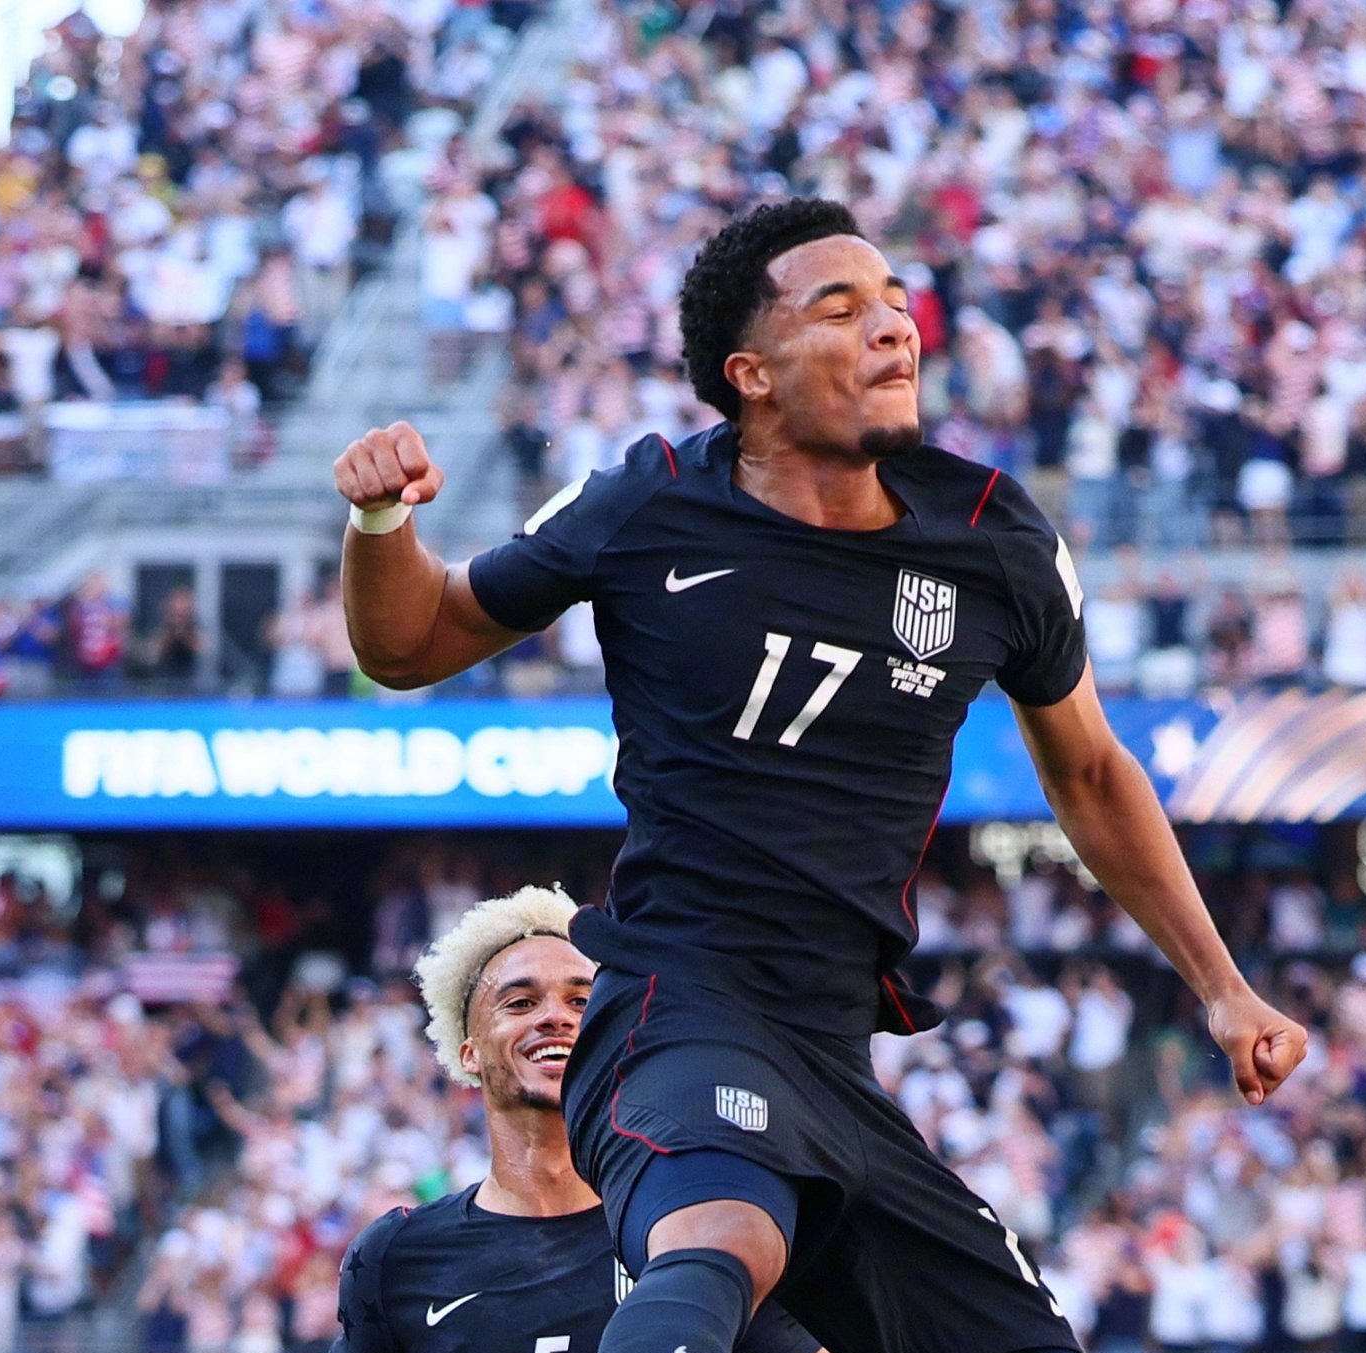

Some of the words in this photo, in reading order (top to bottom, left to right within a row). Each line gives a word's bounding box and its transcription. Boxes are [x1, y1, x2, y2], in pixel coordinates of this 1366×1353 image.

[902, 573, 952, 613] USA
[732, 631, 864, 748] 17
[62, 728, 217, 798] FIFA
[212, 726, 465, 798] WORLD
[464, 725, 609, 798] CUP
[721, 1088, 764, 1112] USA
